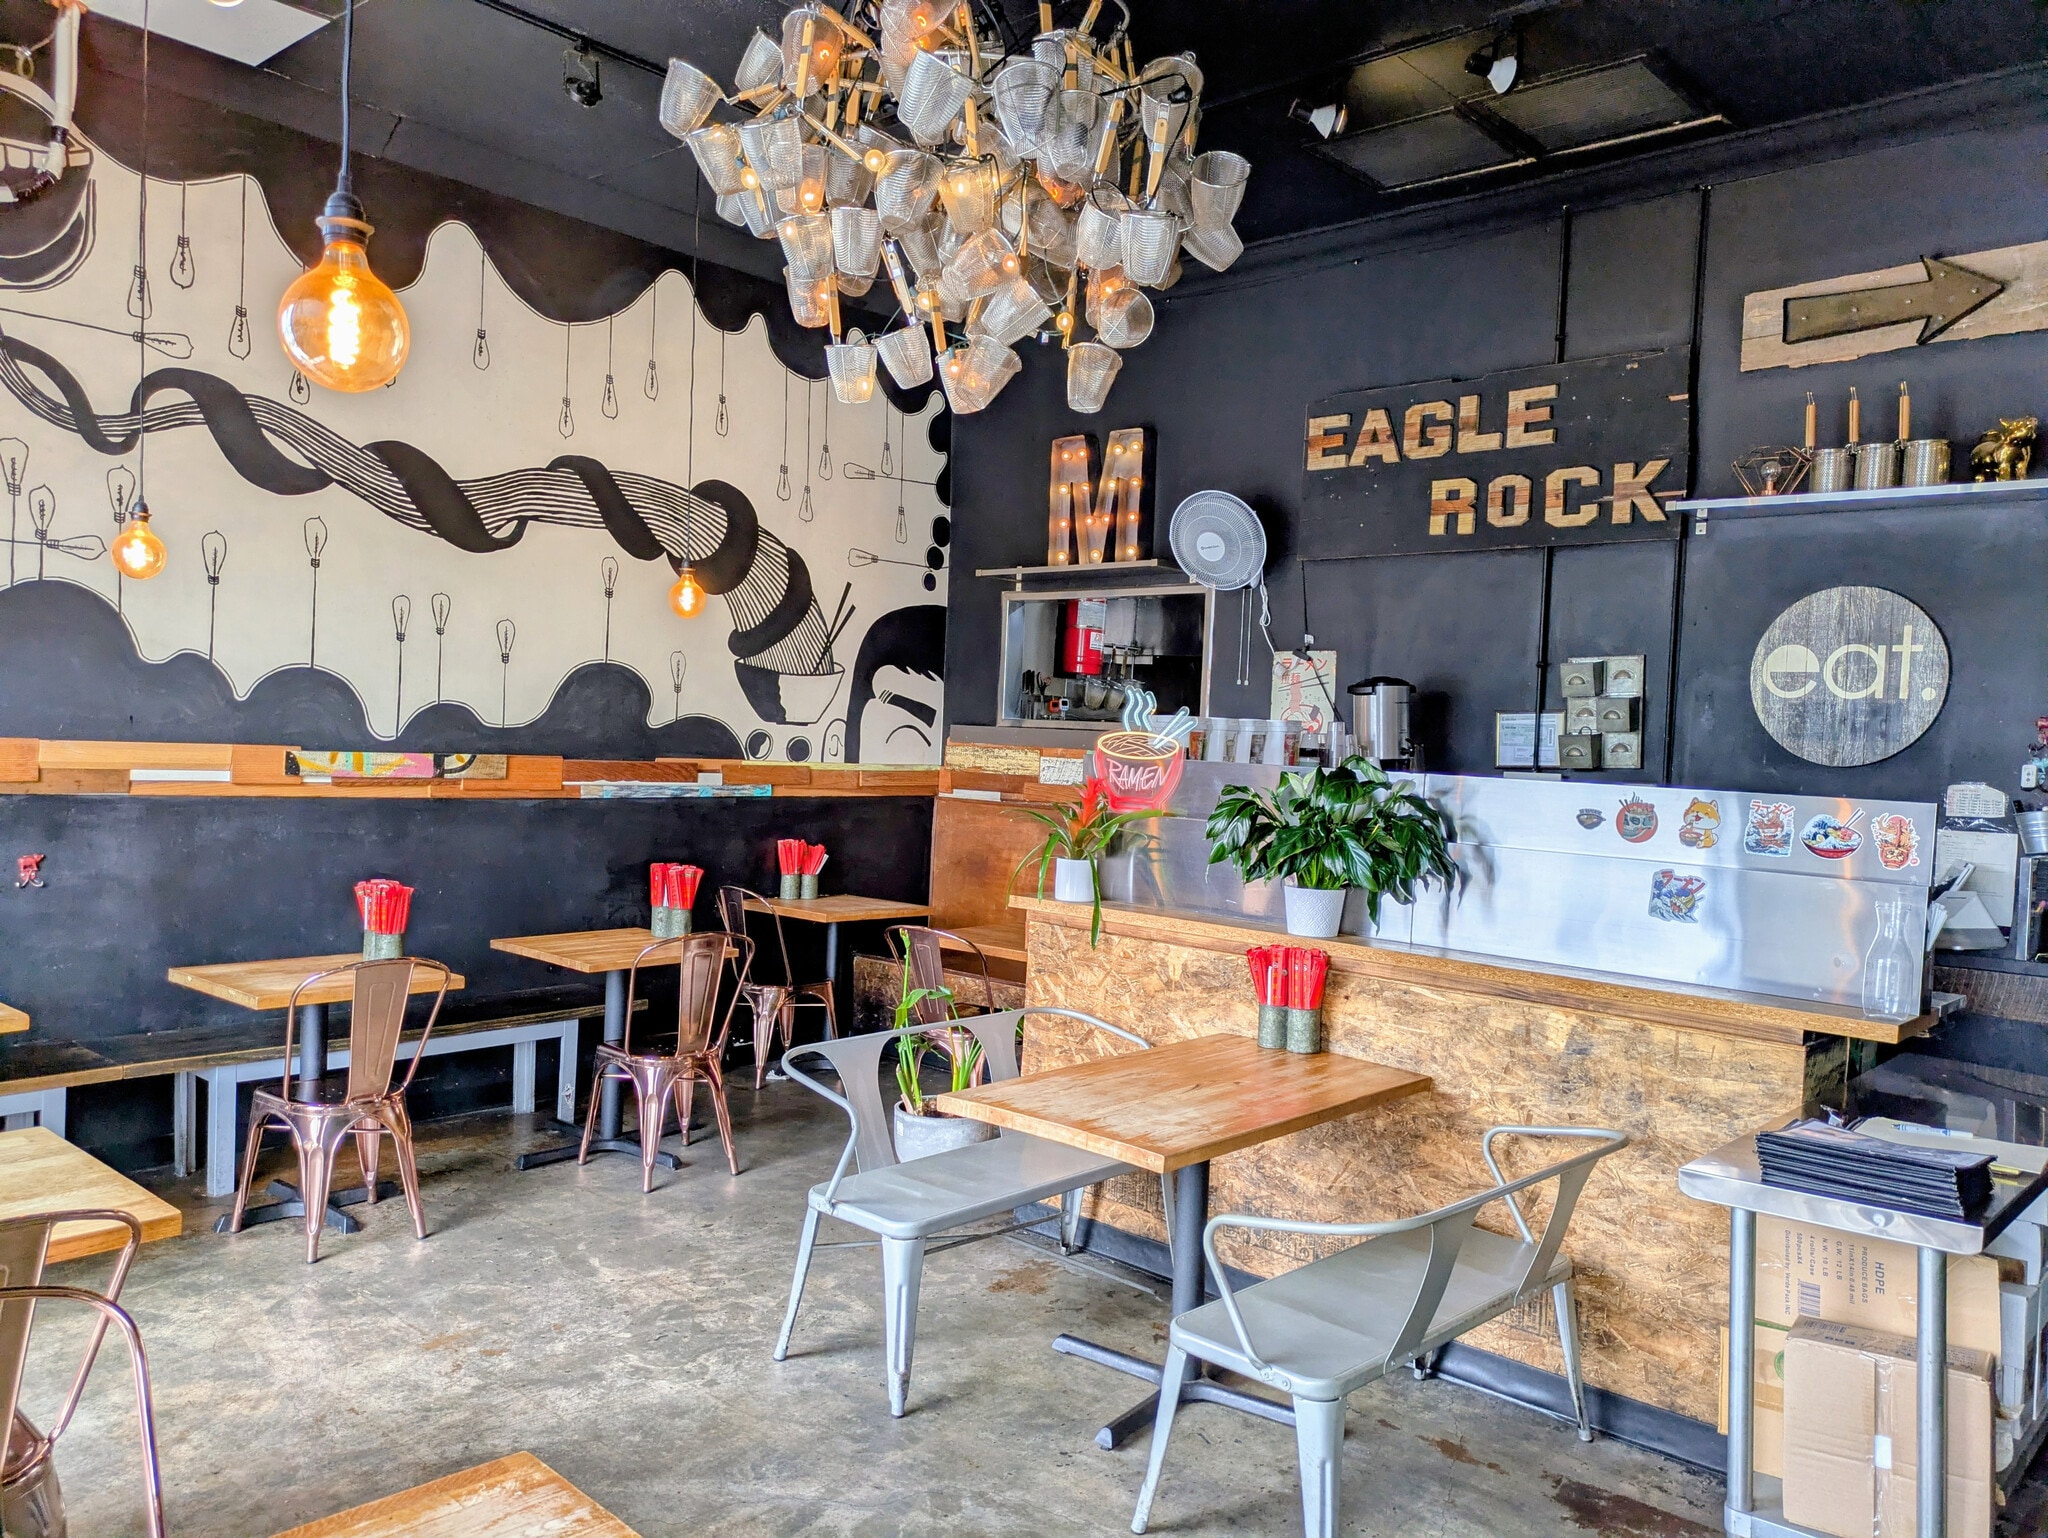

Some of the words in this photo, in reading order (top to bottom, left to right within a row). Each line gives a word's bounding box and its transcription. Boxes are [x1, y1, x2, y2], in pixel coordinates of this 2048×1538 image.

[1307, 384, 1560, 471] EAGLE
[1048, 427, 1154, 567] M
[1429, 459, 1670, 536] ROCK
[1762, 624, 1937, 701] eat.
[1106, 758, 1168, 791] RAMEN
[1661, 870, 1705, 894] ラーメン
[1822, 1267, 1828, 1277] LB
[1836, 1271, 1842, 1280] LB
[1874, 1261, 1885, 1295] HDPE
